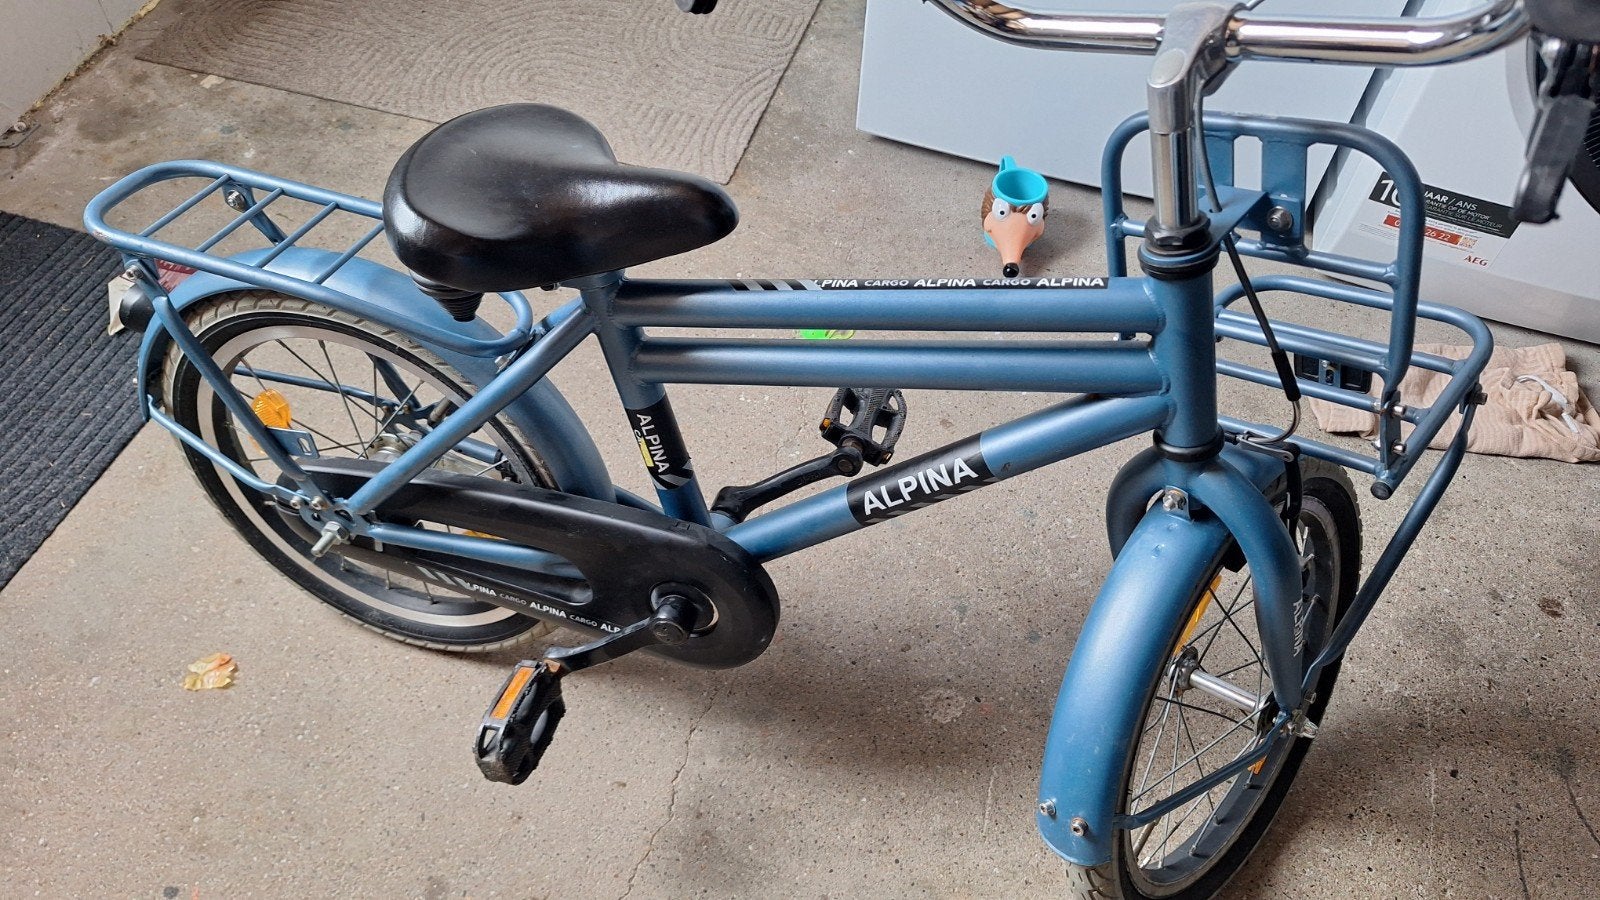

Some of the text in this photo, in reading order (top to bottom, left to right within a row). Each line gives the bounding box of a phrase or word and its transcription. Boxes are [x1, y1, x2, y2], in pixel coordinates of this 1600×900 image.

[1455, 200, 1478, 211] ANS
[1466, 211, 1490, 221] MOTOR
[1464, 255, 1488, 267] AEG
[814, 277, 1105, 288] LPINA CARGO ALPINA CARGO ALPINA
[637, 413, 670, 473] ALPINA
[864, 457, 979, 516] ALPINA
[467, 582, 621, 634] LPINA CARGO ALPINA CARGO ALP
